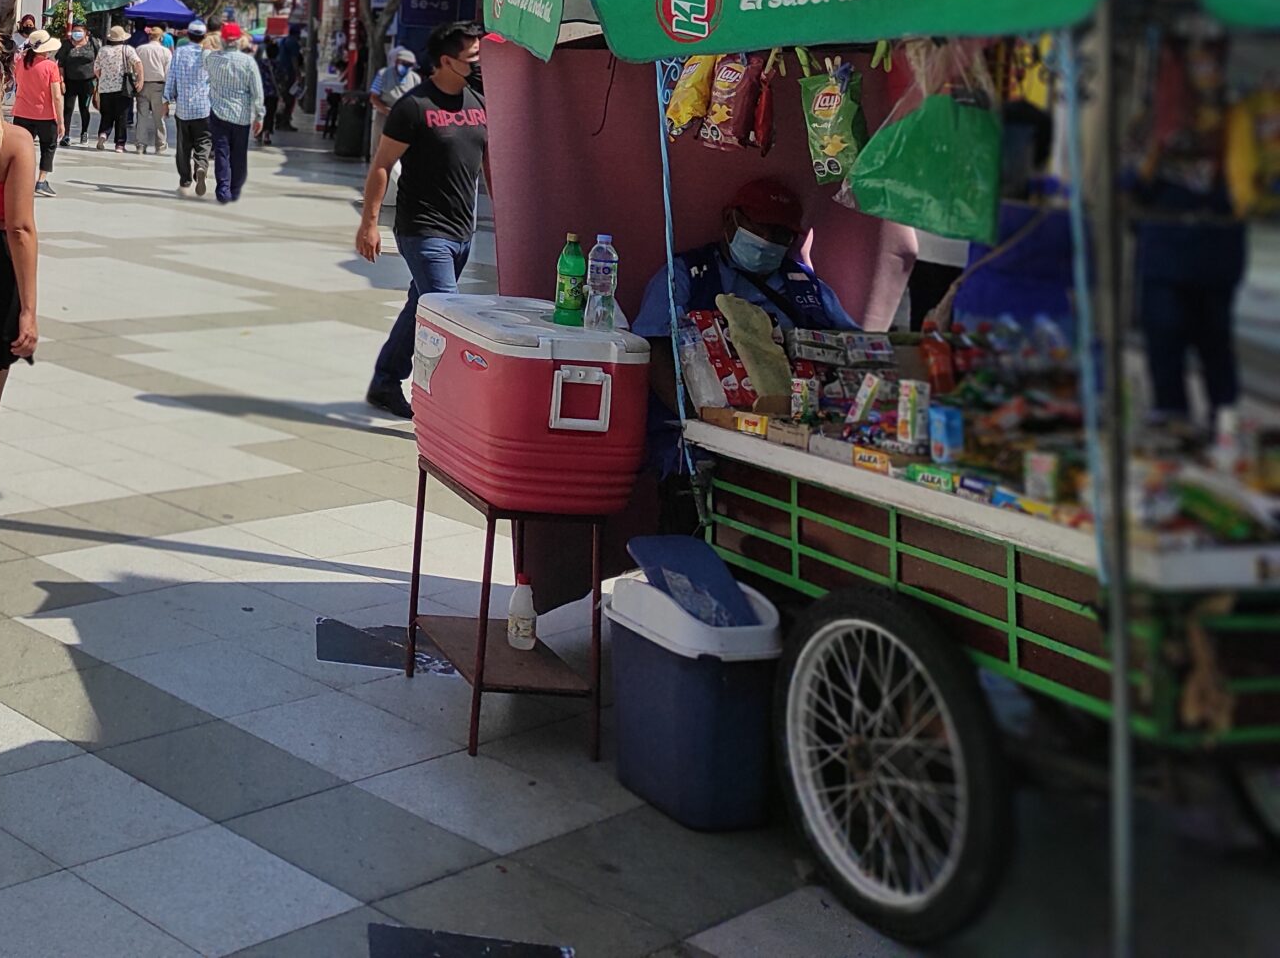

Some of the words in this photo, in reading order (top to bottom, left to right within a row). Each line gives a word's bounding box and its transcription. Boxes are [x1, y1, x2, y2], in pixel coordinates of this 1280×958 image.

[590, 264, 611, 274] ELO
[796, 295, 821, 306] CIEL
[858, 453, 878, 465] ALKA
[920, 473, 943, 486] ALKA
